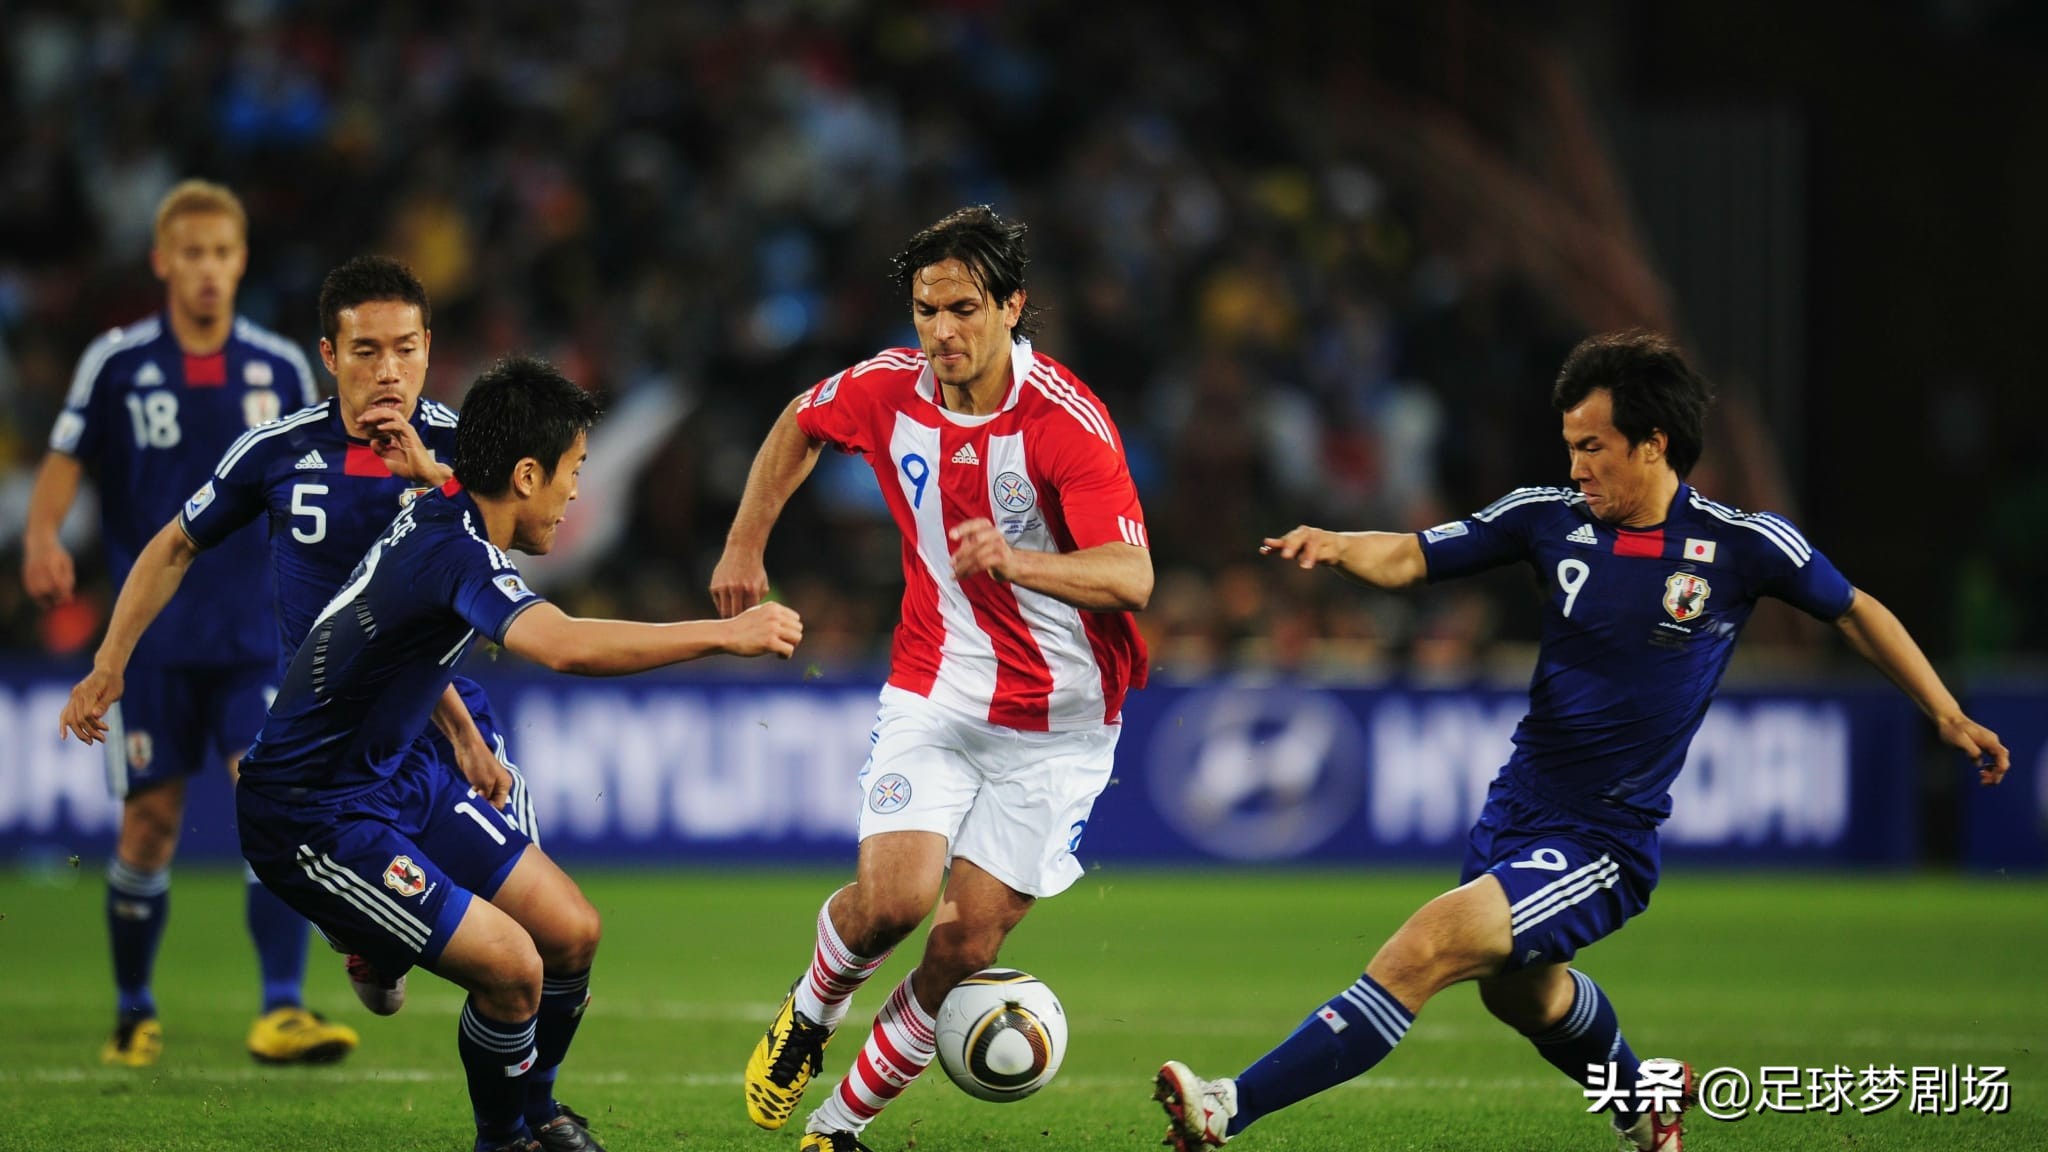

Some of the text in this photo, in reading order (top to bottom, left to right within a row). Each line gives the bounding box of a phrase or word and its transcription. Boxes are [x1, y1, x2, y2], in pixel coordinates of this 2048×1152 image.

[126, 391, 181, 449] 18
[901, 453, 930, 510] 9
[291, 483, 329, 544] 5
[1557, 558, 1590, 618] 9
[1510, 848, 1568, 871] 9
